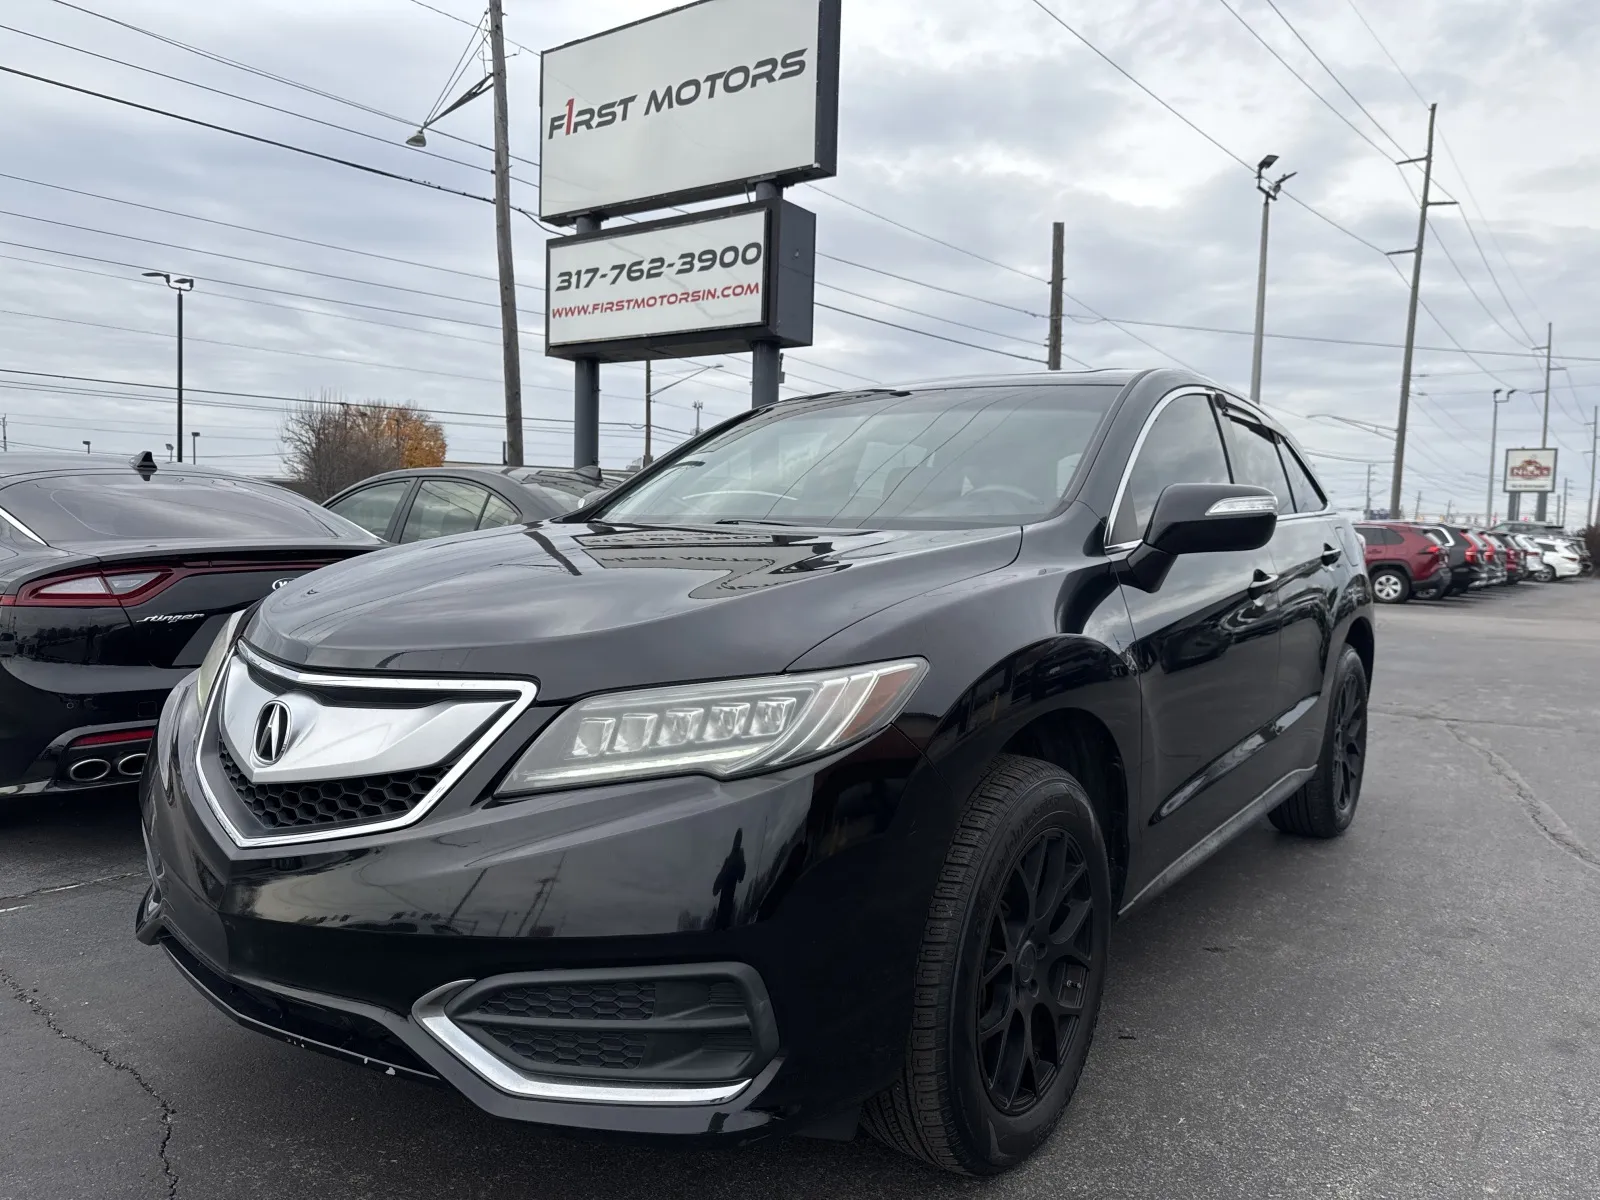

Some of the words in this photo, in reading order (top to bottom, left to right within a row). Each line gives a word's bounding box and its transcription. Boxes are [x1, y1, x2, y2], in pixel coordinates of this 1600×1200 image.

[643, 47, 808, 117] MOTORS
[555, 242, 763, 292] 317-762-3900
[551, 282, 760, 319] WWW.FIRSTMOTORSIN.COM
